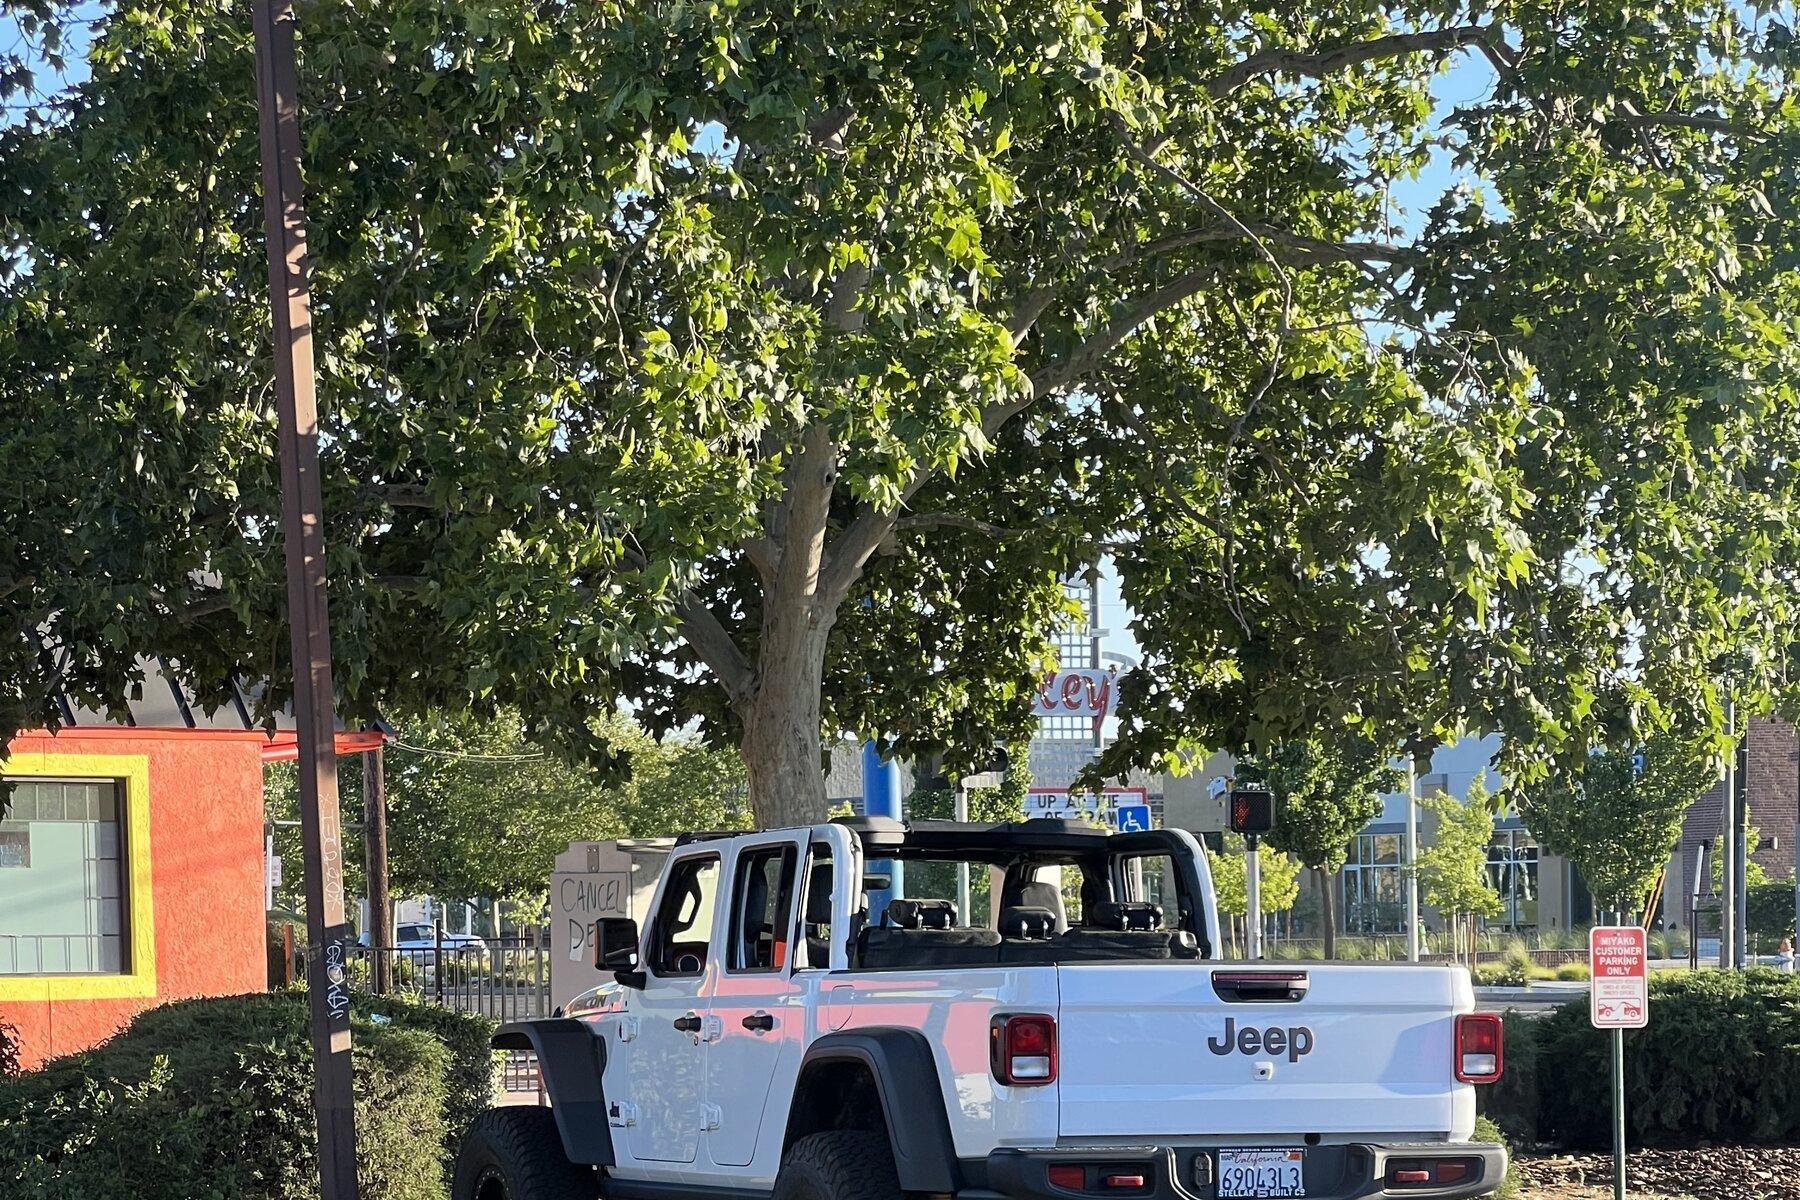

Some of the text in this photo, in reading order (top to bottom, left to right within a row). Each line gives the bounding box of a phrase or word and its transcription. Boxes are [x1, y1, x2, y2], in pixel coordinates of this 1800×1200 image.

[1038, 795, 1057, 809] UP
[561, 878, 625, 914] CANCEL
[569, 918, 595, 950] DE
[1601, 937, 1636, 946] MIYAKO
[1595, 946, 1642, 956] CUSTOMER
[1599, 956, 1638, 966] PARKING
[1607, 966, 1631, 976] ONLY
[1208, 1017, 1314, 1063] Jeep
[1234, 1152, 1289, 1166] California
[1222, 1167, 1300, 1190] 69043L3
[1218, 1189, 1254, 1198] STELLAR
[1269, 1188, 1293, 1197] BUILT
